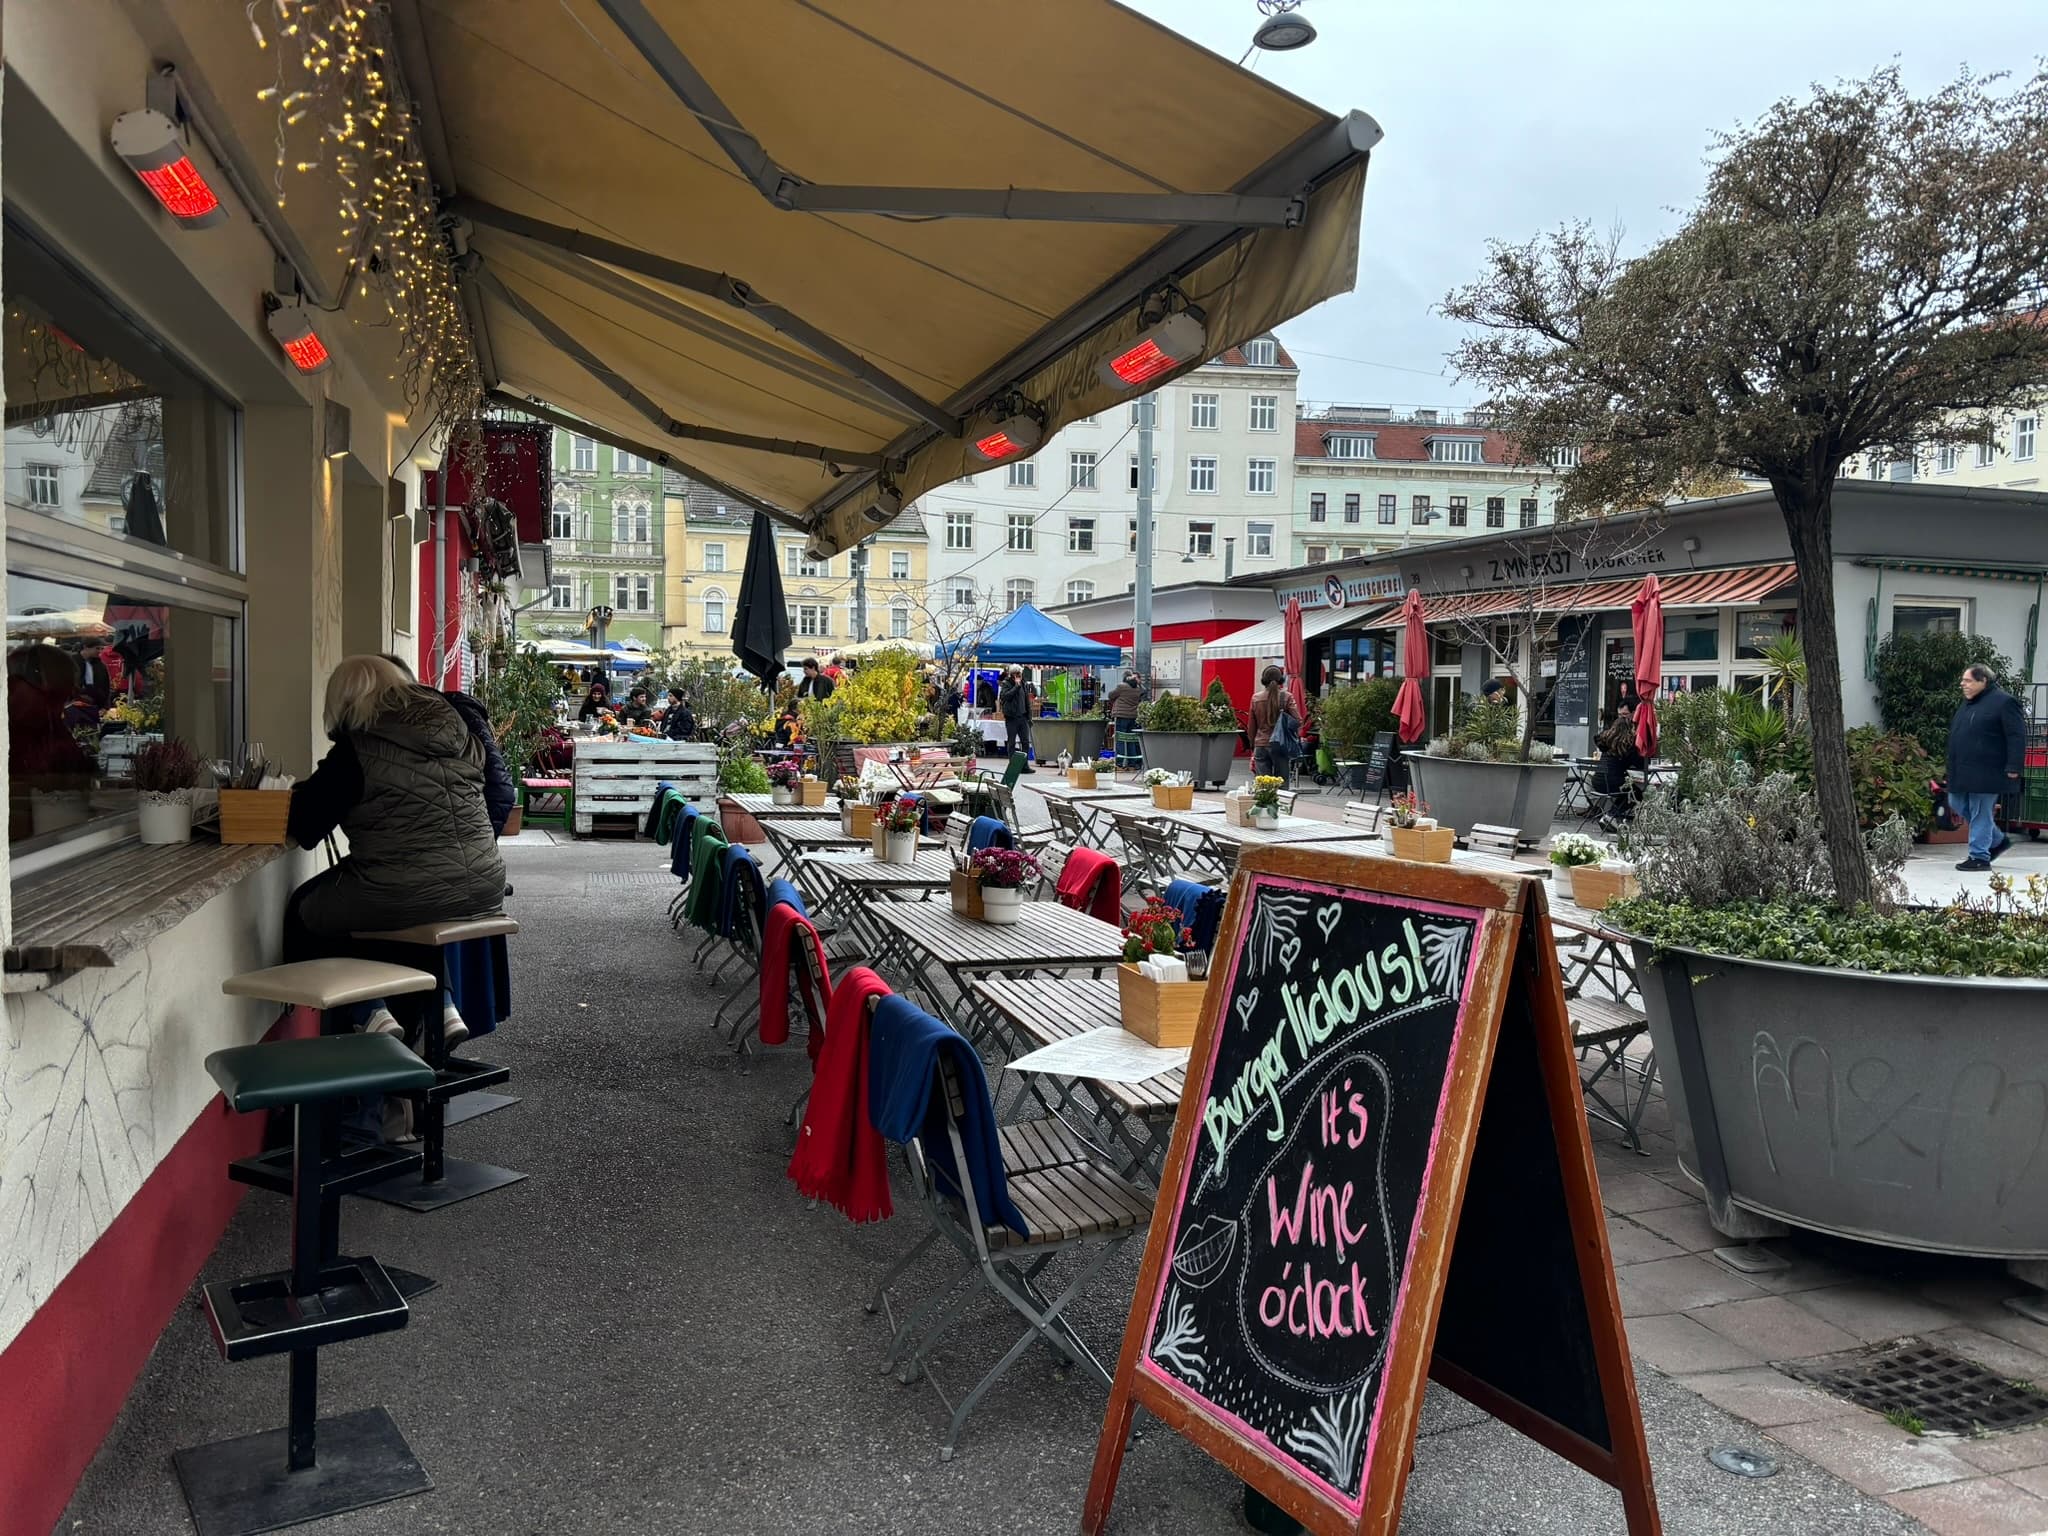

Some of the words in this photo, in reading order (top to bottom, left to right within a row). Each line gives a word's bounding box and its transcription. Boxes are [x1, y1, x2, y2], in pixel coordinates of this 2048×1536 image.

[1349, 577, 1402, 597] FLEISCHEREI
[1488, 551, 1570, 581] ZMMER37
[1320, 1078, 1368, 1149] It's
[1267, 1160, 1368, 1264] Wine
